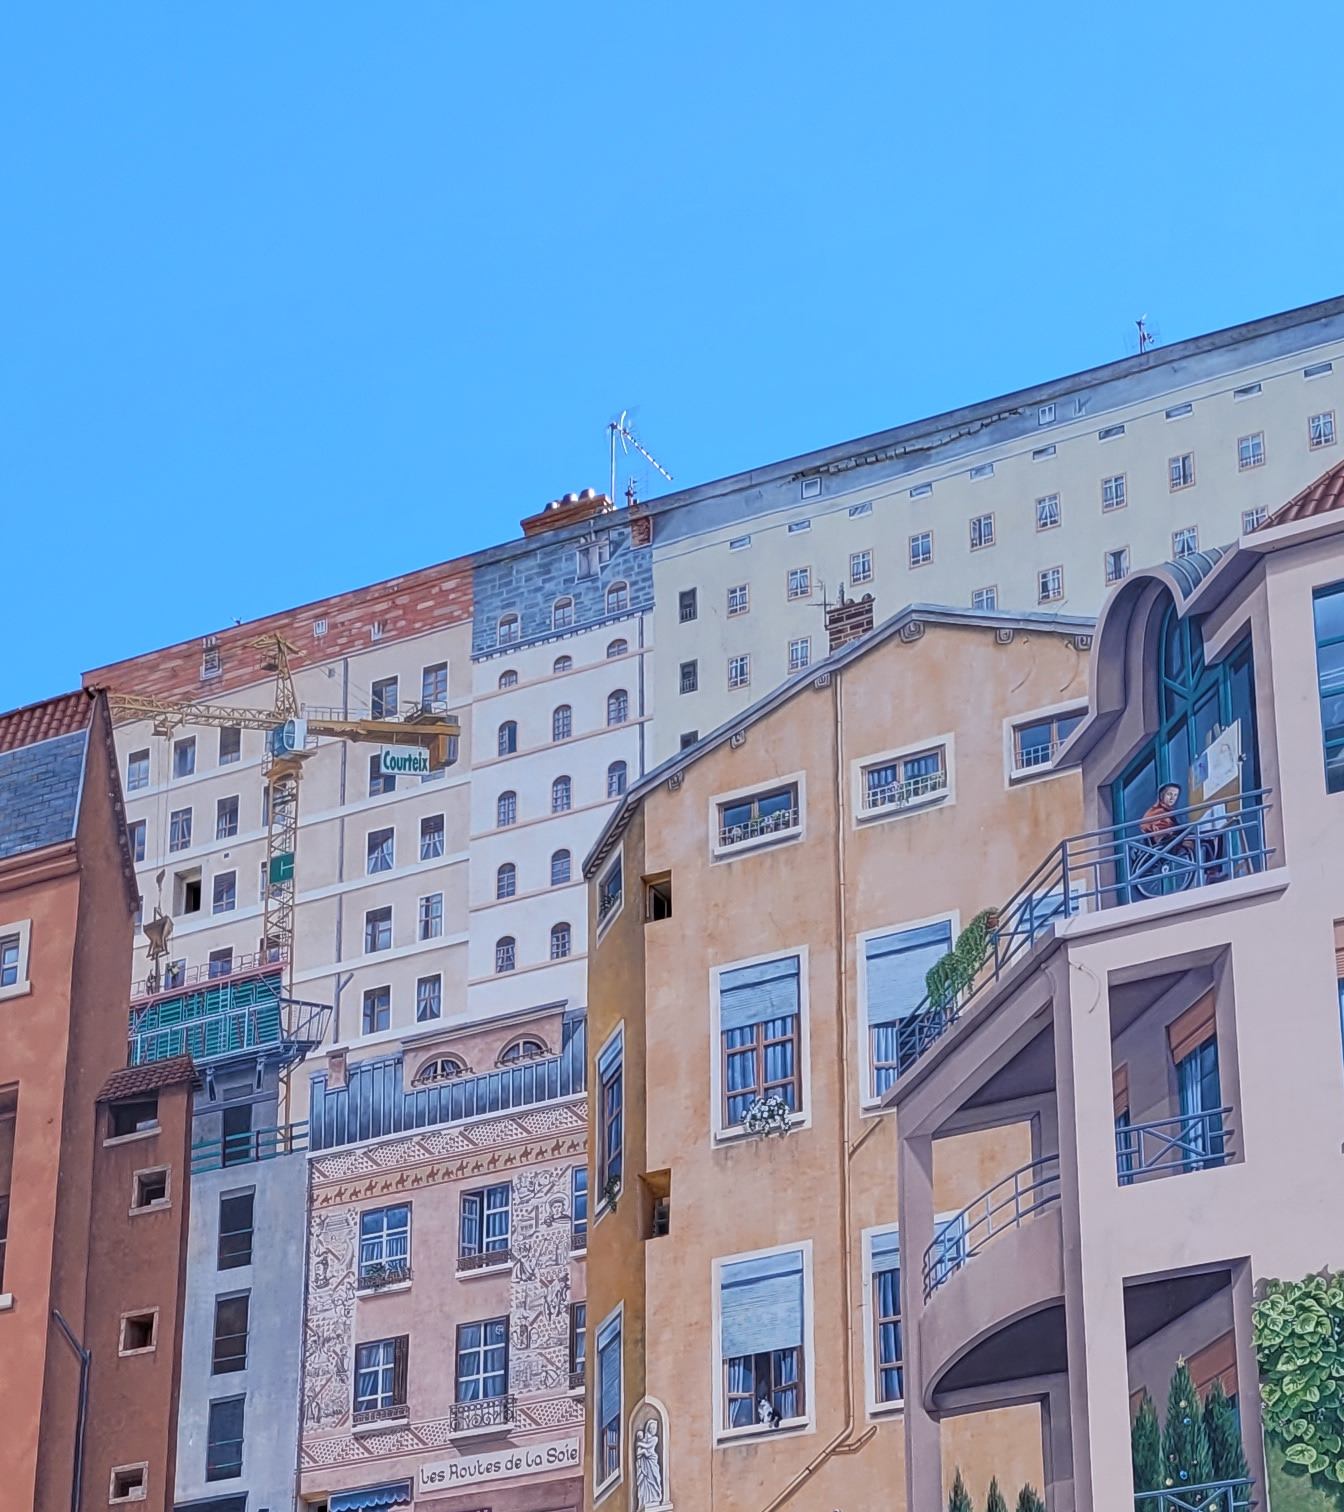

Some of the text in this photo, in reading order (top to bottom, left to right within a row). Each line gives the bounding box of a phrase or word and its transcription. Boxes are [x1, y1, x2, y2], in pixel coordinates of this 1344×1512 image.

[383, 750, 429, 772] Courteix
[421, 1443, 578, 1485] Les Routes de La Soie
